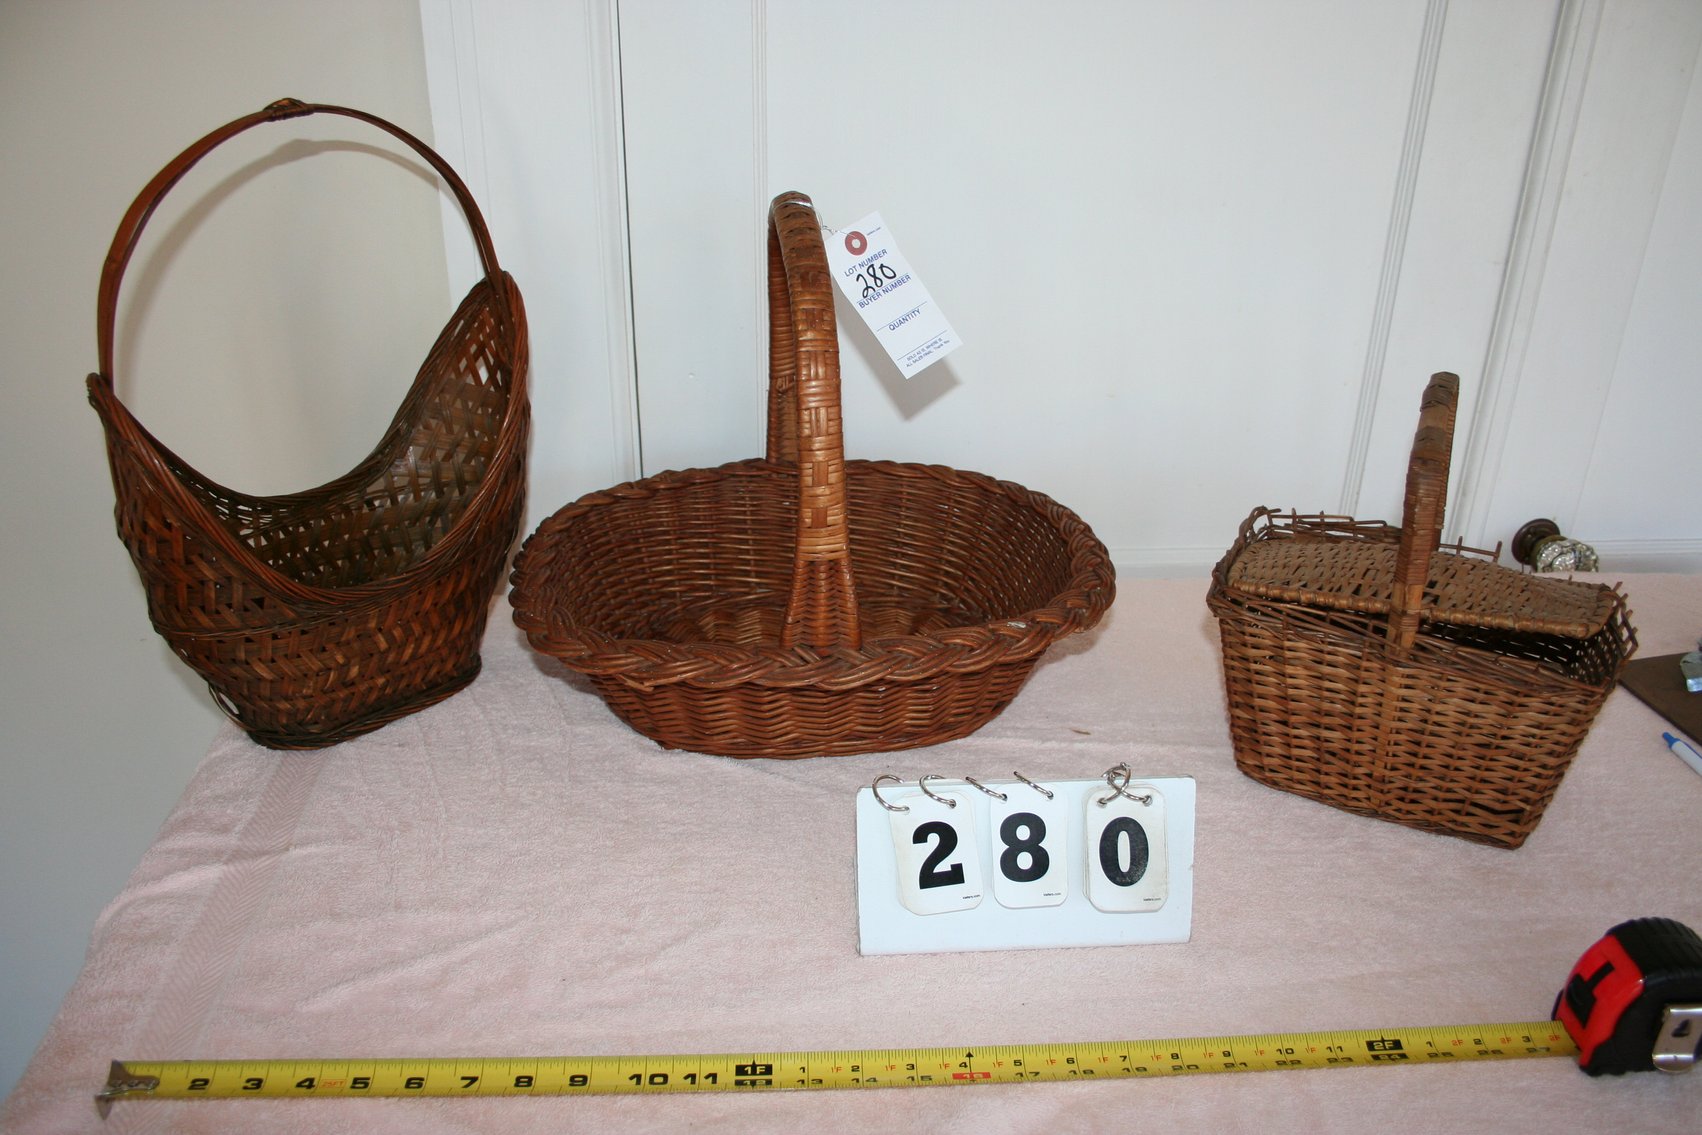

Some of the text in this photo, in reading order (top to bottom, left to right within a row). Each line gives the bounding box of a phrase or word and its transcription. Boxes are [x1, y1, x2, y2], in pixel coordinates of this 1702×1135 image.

[844, 249, 888, 277] LOT NUMBER
[856, 264, 896, 299] 280
[858, 274, 912, 308] BUYER NUMBER
[888, 308, 922, 331] QUANTITY
[912, 812, 1149, 890] 2 8 0
[188, 1079, 210, 1090] 2
[242, 1078, 264, 1090] 3
[296, 1078, 316, 1089] 4
[350, 1078, 370, 1089] 5
[404, 1077, 425, 1089] 6
[460, 1076, 479, 1088] 7
[514, 1076, 534, 1087] 8
[568, 1075, 588, 1086] 9
[628, 1073, 669, 1085] 10
[683, 1073, 718, 1085] 11
[744, 1066, 765, 1074] 1F
[1373, 1041, 1394, 1050] 2F
